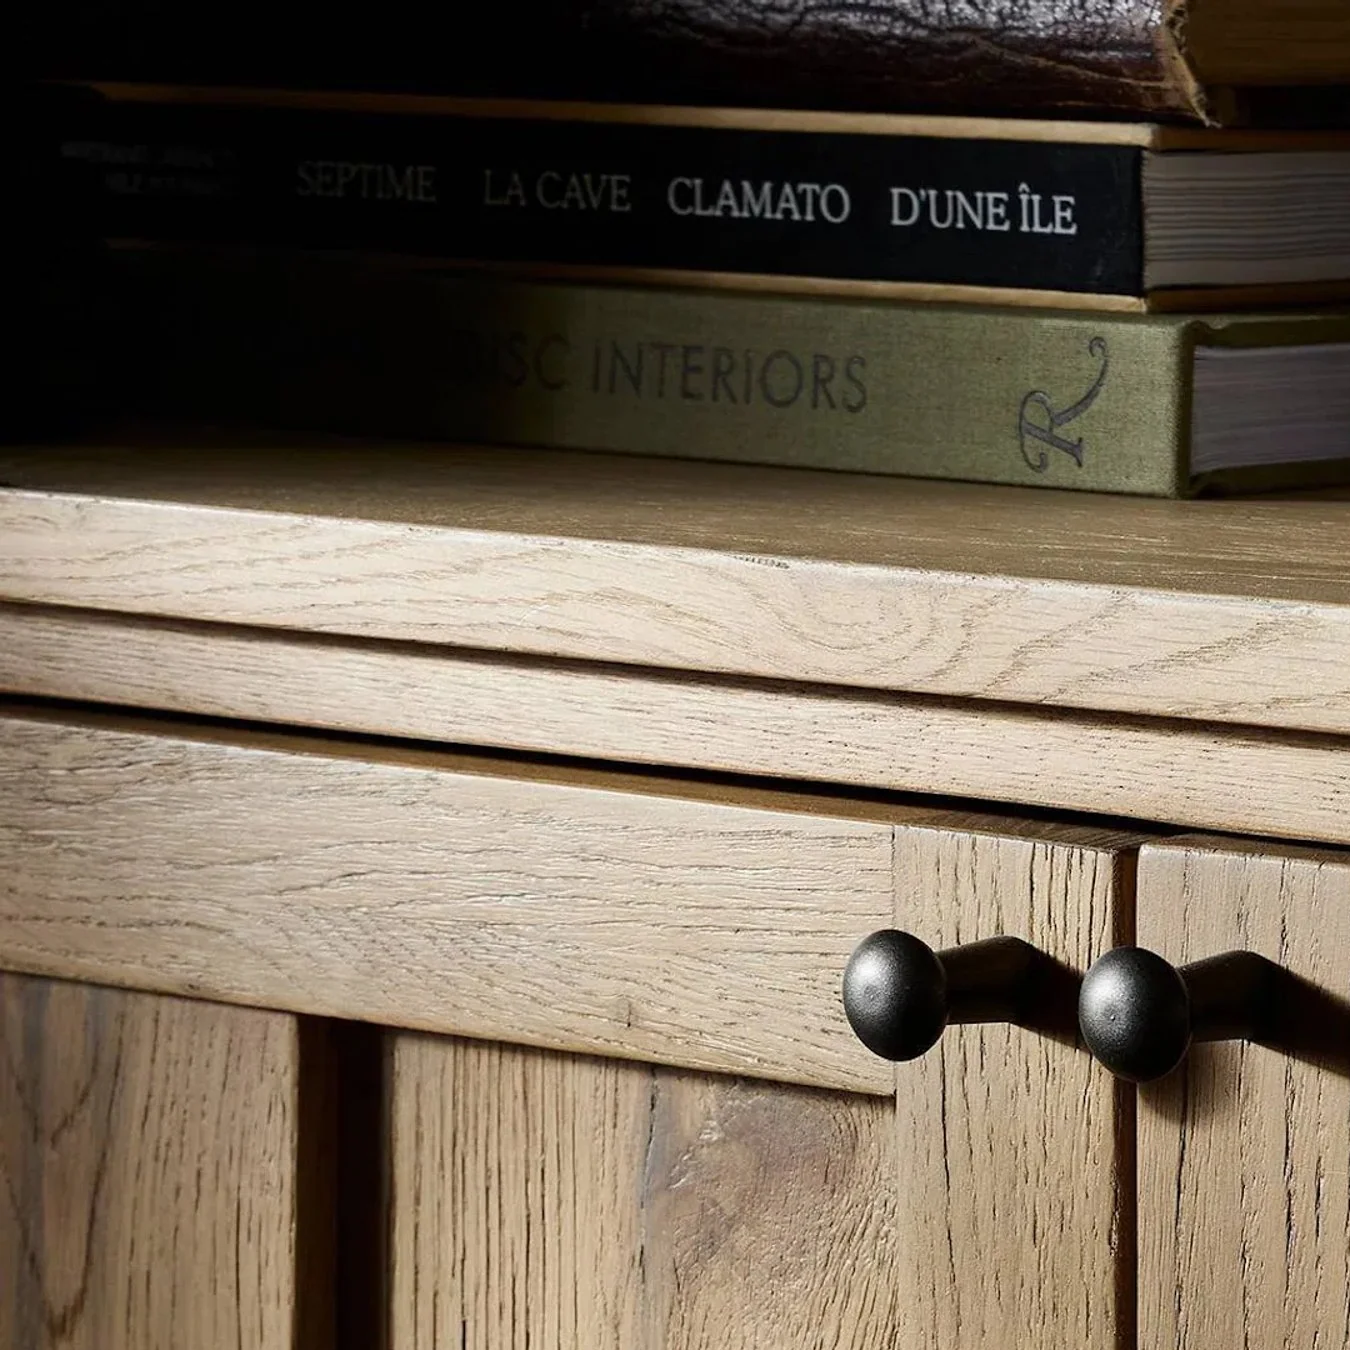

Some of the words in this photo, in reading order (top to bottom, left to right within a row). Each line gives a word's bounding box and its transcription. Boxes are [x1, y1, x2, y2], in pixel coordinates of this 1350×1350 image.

[296, 159, 438, 203] SEPTIME
[482, 167, 529, 208] LA
[536, 170, 632, 213] CAVE
[667, 177, 851, 225] CLAMATO
[889, 185, 1010, 233] D'UNE
[1018, 183, 1078, 236] ÎLE
[590, 340, 868, 413] INTERIORS
